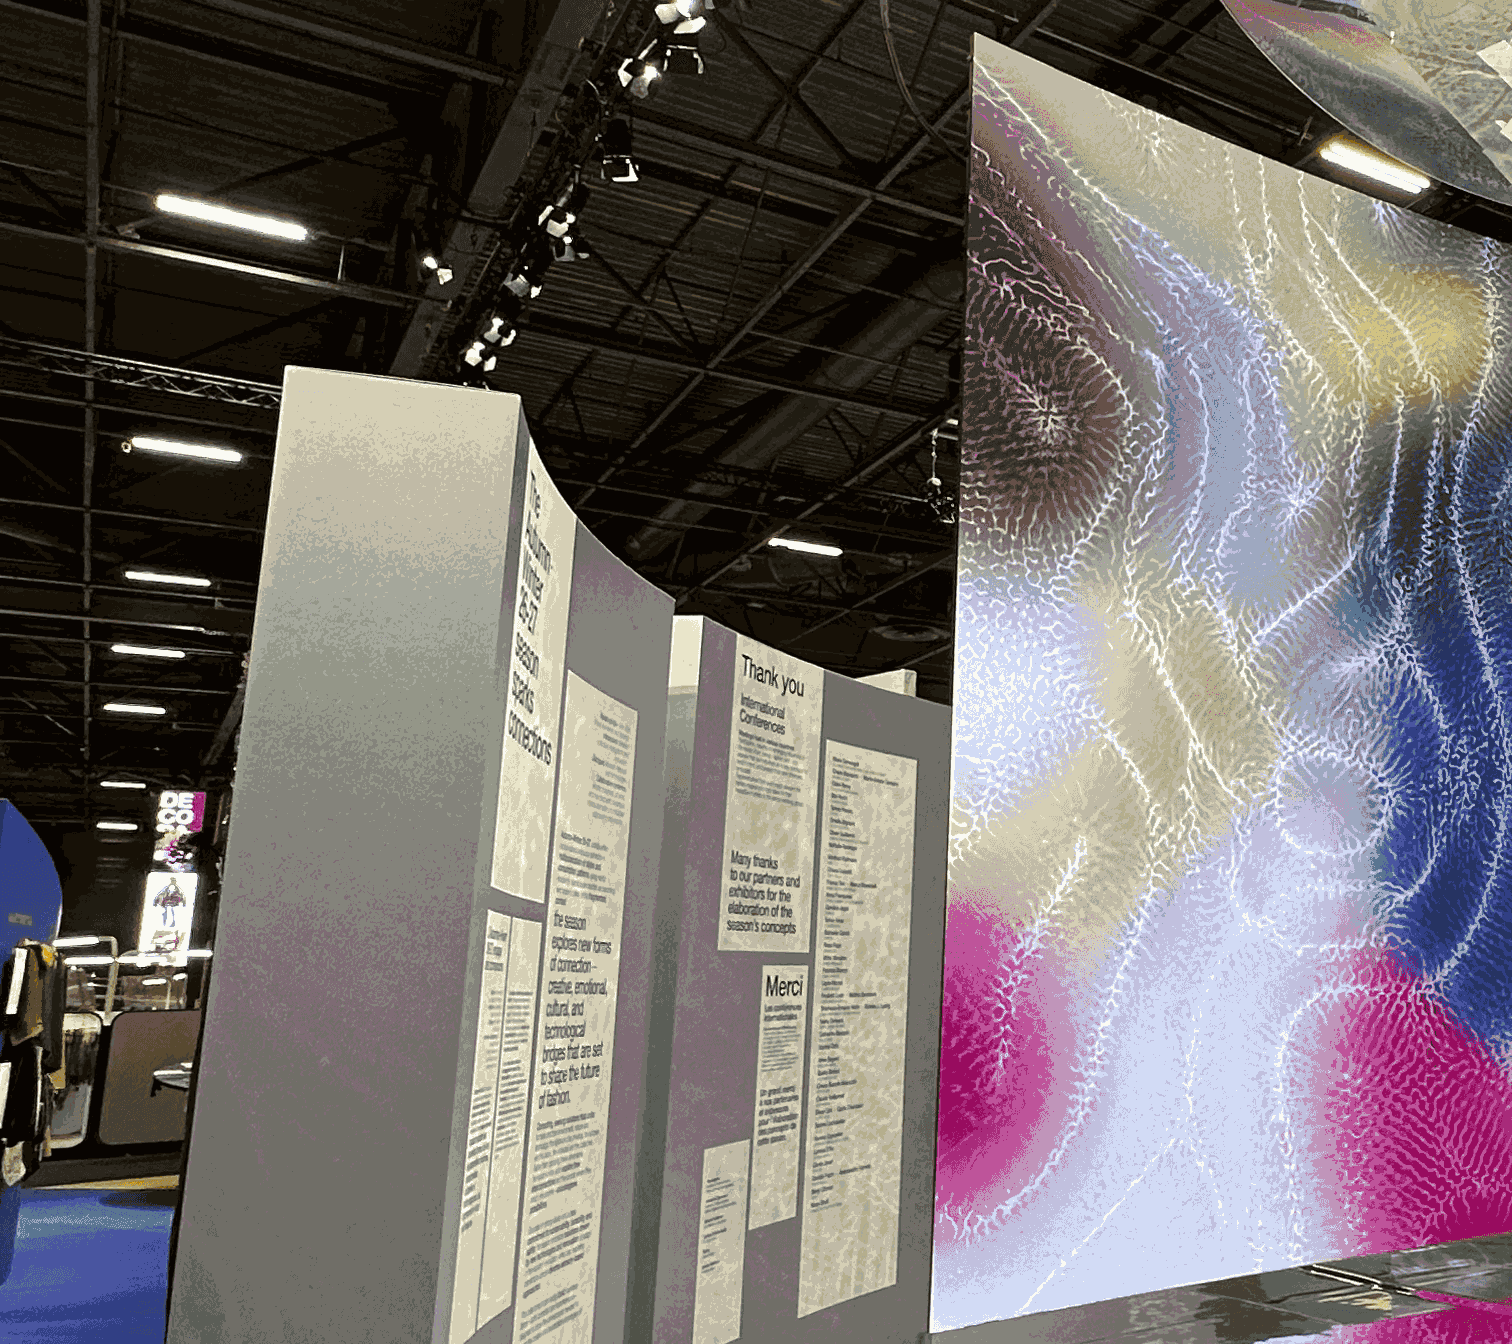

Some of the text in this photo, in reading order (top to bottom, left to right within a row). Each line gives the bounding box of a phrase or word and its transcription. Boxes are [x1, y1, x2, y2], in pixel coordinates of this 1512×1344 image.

[741, 653, 805, 698] Thank you
[740, 692, 786, 720] International
[739, 707, 786, 736] Conferences
[508, 708, 553, 767] connections
[160, 791, 195, 809] DE
[157, 808, 195, 825] CO
[730, 849, 779, 871] Many thanks
[730, 867, 801, 889] to our partners and
[728, 884, 792, 903] exhibitors for the
[553, 909, 587, 931] the season
[727, 900, 794, 919] elaboration of the
[760, 922, 797, 937] concepts
[551, 933, 612, 955] explores new forms
[549, 954, 558, 972] of
[765, 974, 804, 997] Merci
[571, 999, 585, 1017] and
[567, 1043, 580, 1060] that
[580, 1044, 592, 1059] are
[540, 1068, 548, 1086] to
[568, 1063, 580, 1082] the
[580, 1062, 601, 1080] future
